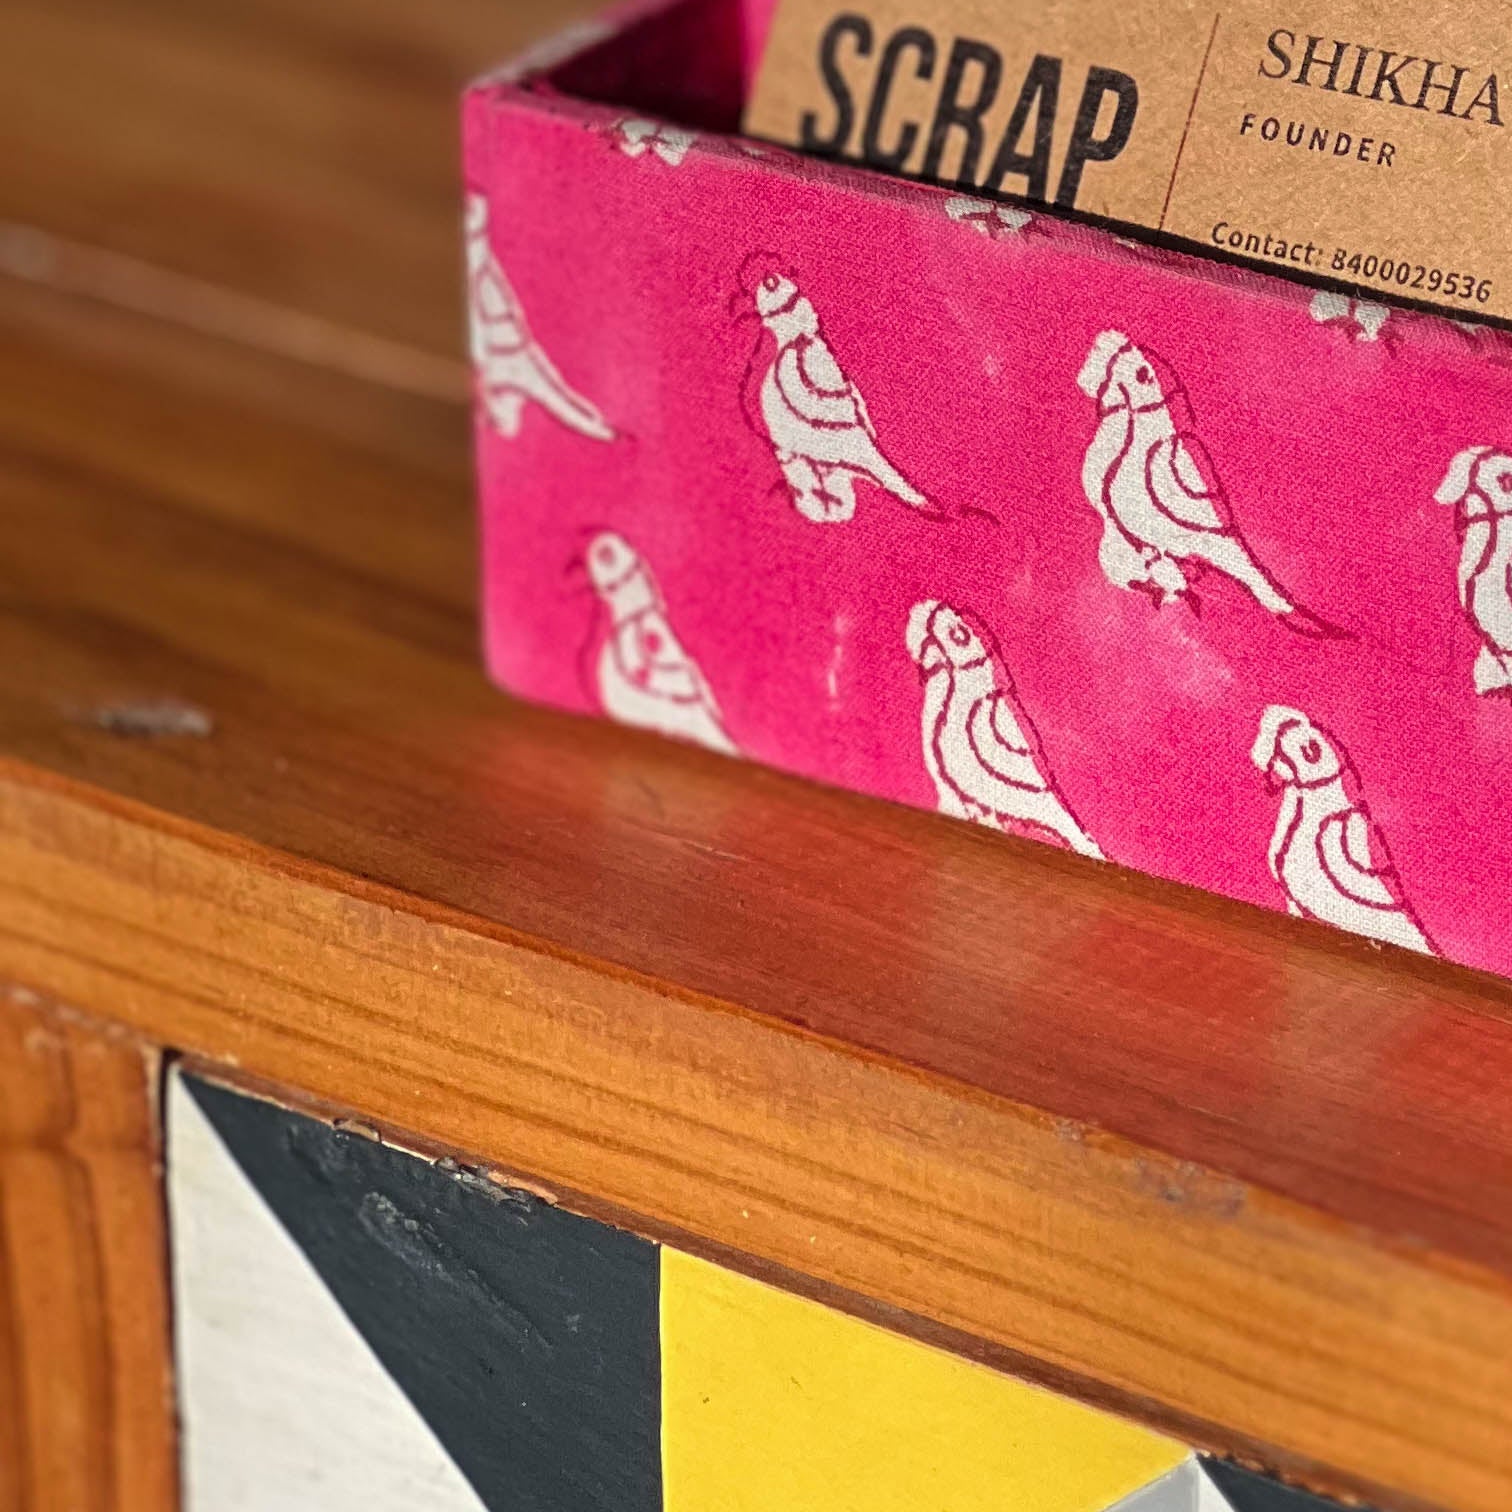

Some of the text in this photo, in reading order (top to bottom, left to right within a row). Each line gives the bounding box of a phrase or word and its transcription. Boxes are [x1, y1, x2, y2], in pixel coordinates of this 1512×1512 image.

[799, 11, 1140, 209] SCRAP
[1257, 28, 1505, 127] SHIKHA
[1239, 112, 1397, 167] FOUNDER
[1211, 221, 1493, 303] Contact: 8400029536
